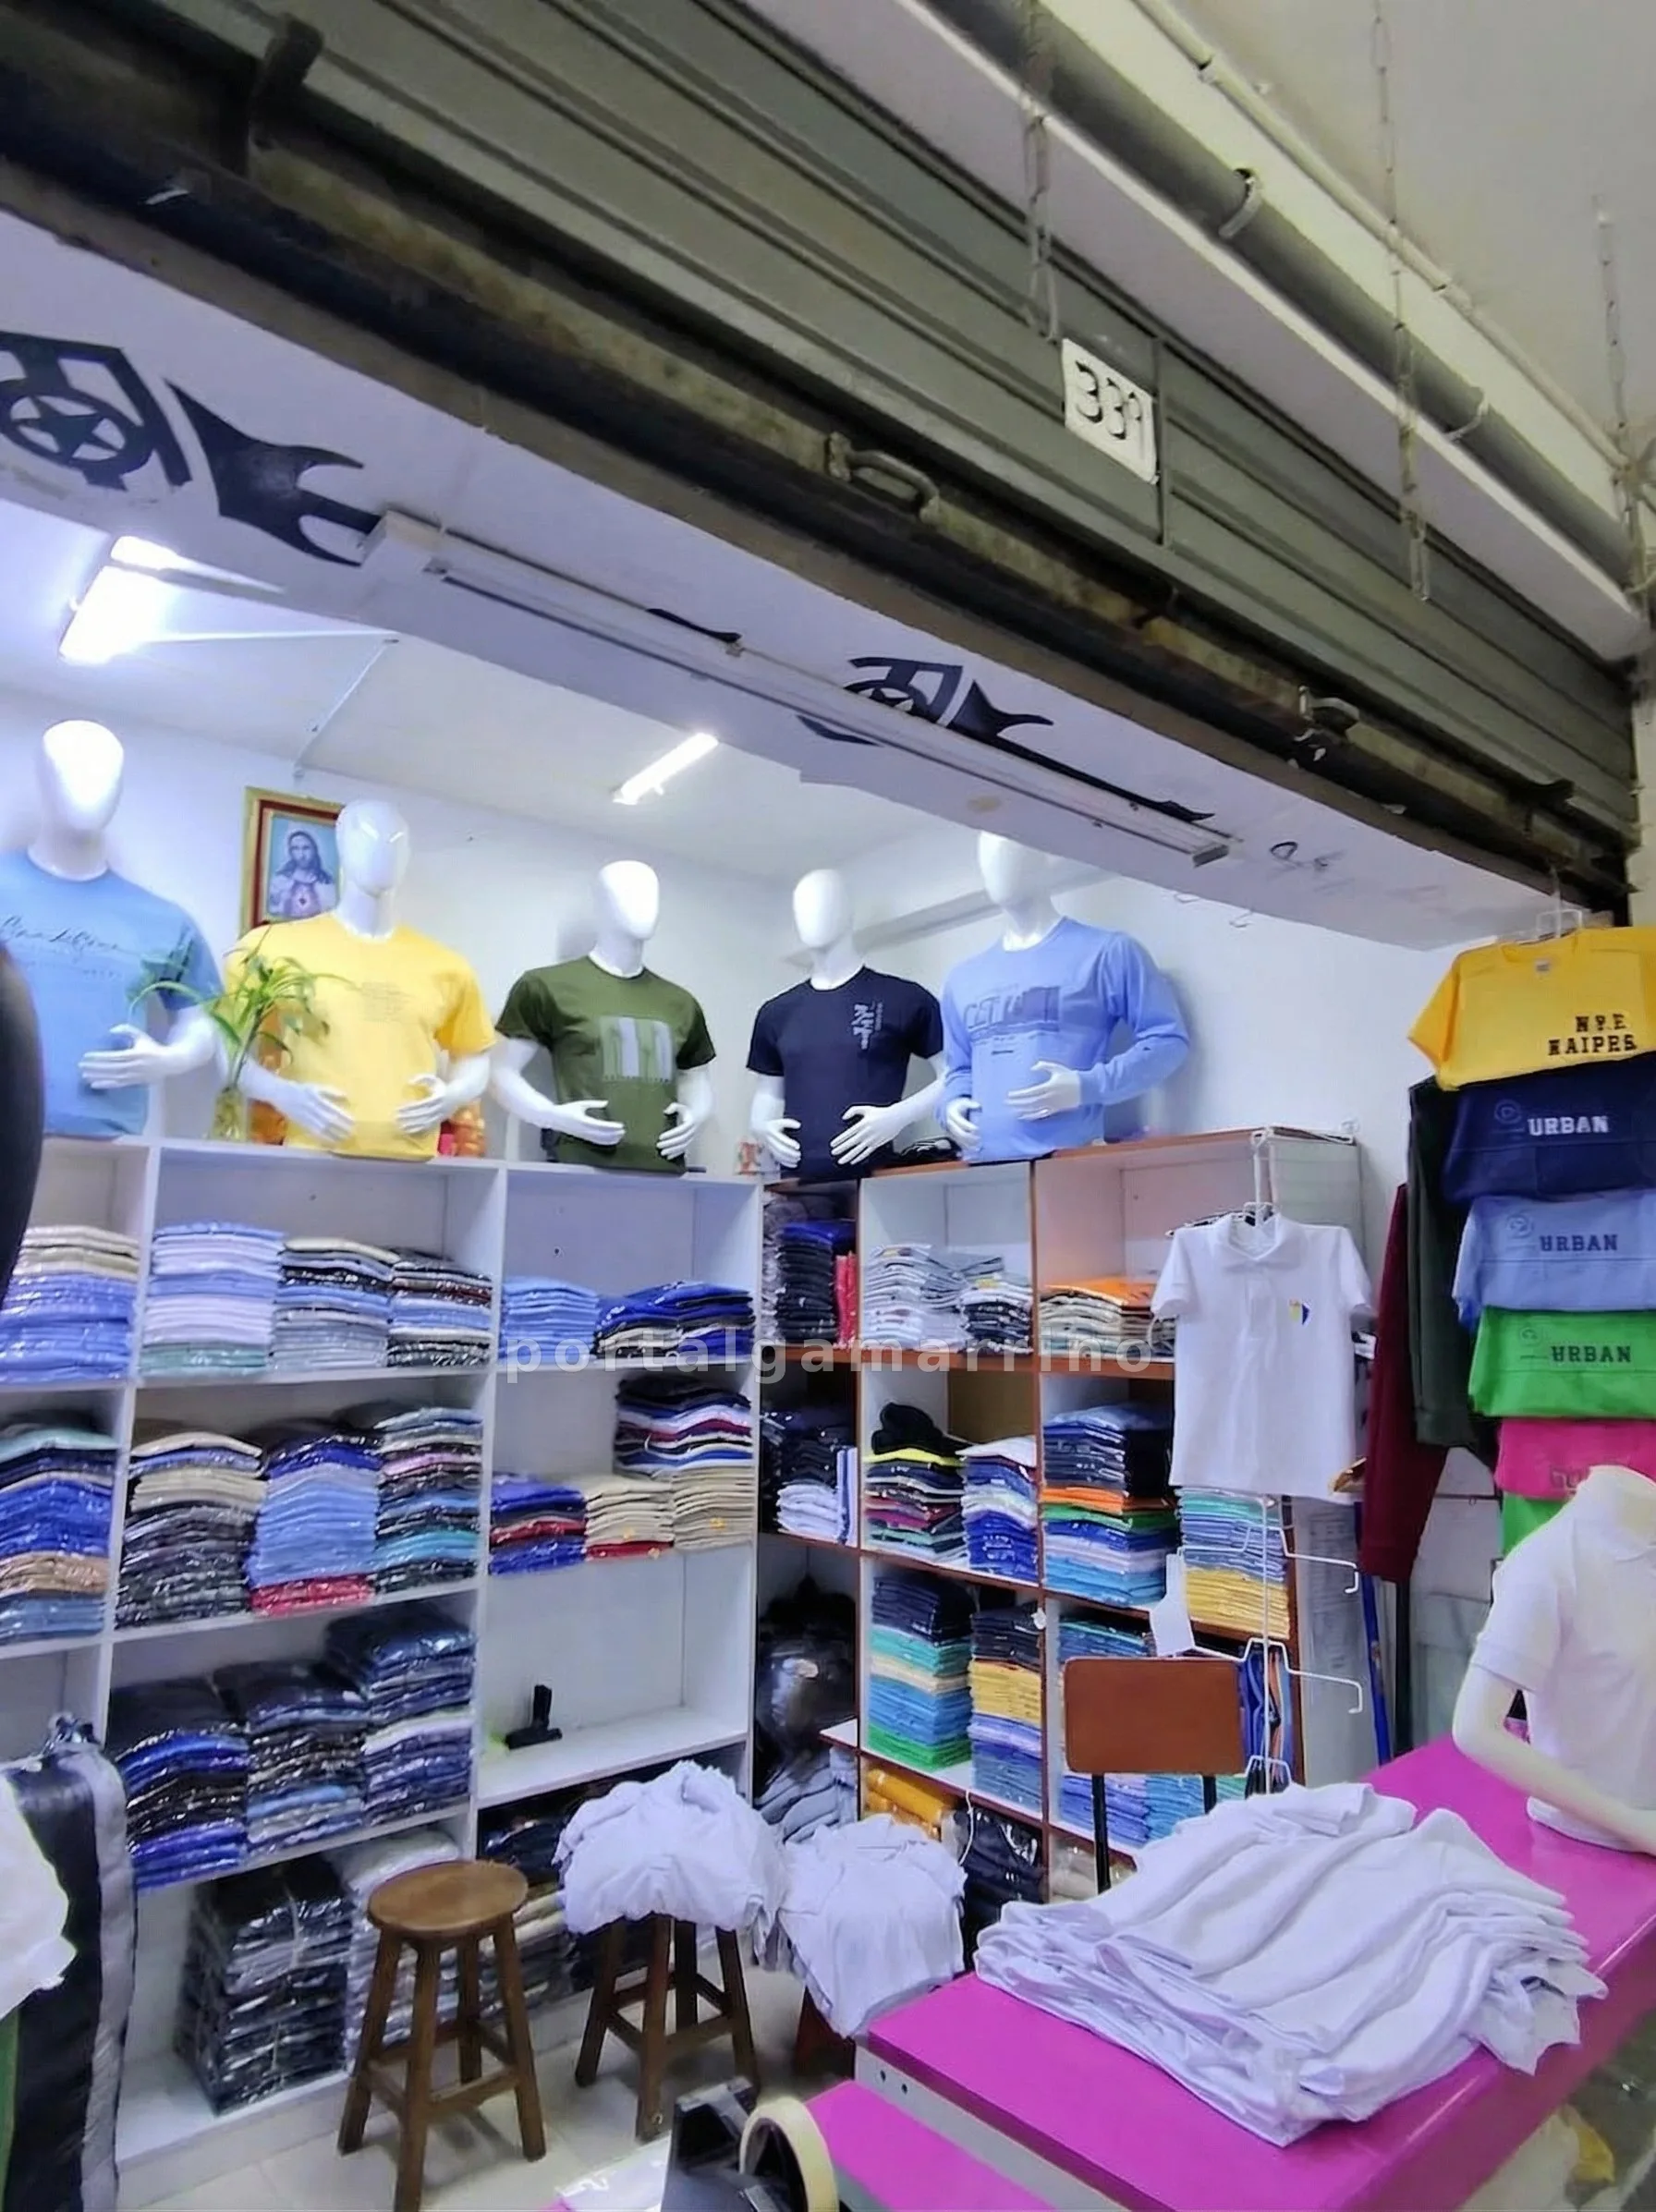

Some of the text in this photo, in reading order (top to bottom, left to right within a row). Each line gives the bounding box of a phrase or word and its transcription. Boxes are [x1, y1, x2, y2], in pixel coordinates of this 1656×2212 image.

[1527, 1114, 1609, 1136] URBAN
[1539, 1234, 1618, 1252] URBAN
[1551, 1344, 1632, 1363] URBAN
